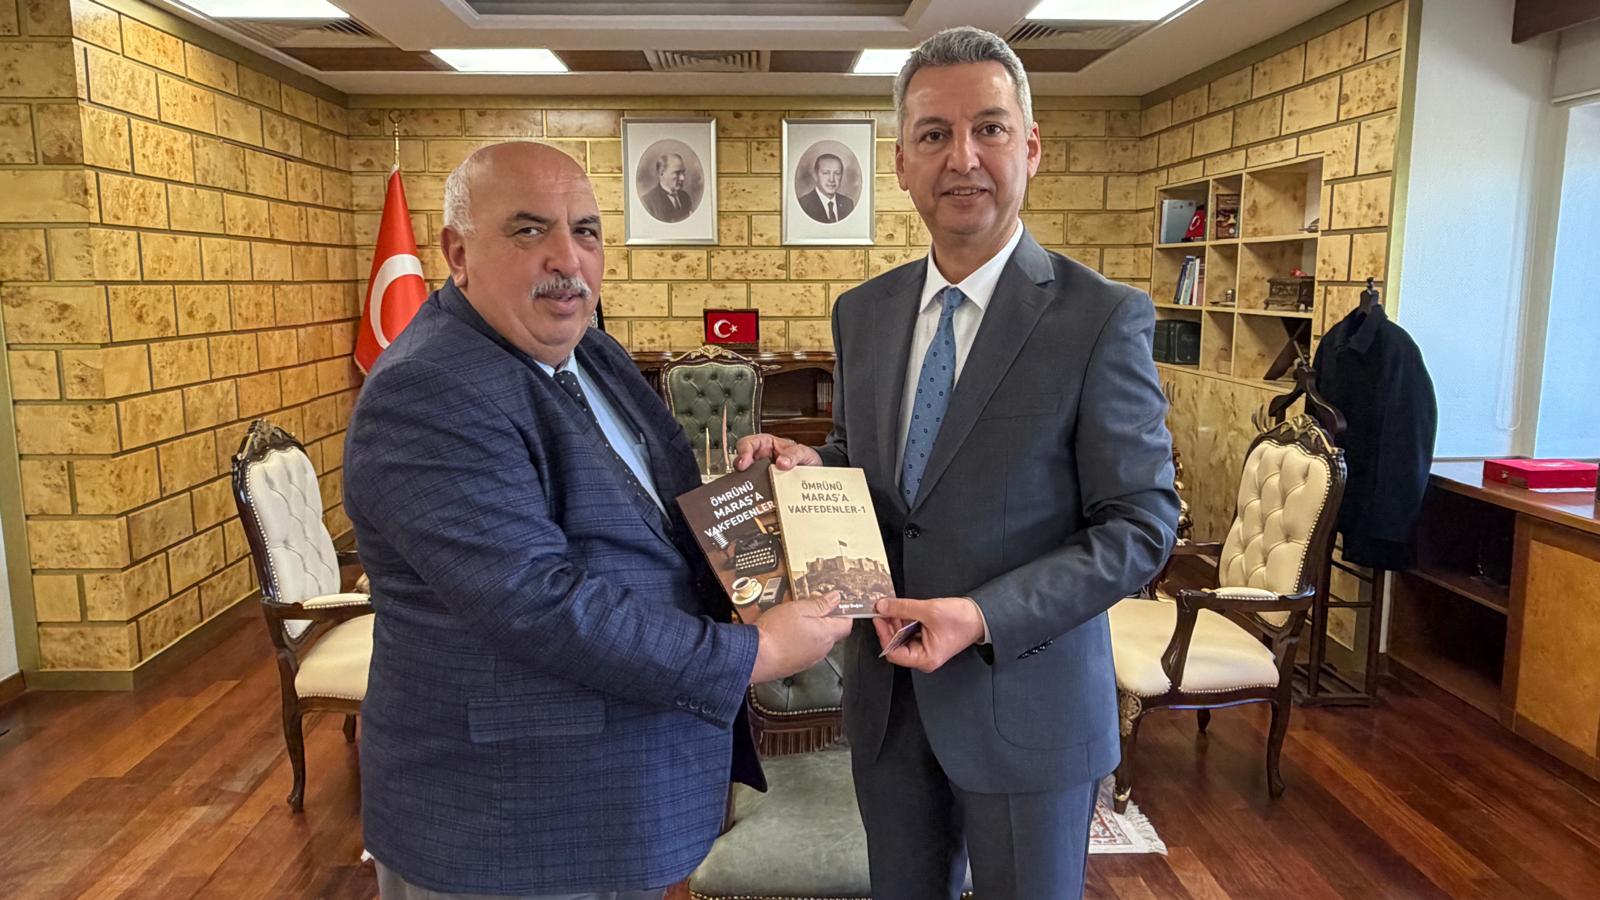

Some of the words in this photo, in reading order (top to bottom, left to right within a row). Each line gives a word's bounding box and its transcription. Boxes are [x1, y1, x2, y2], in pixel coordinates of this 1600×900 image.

[709, 480, 754, 506] ÖMRÜNÜ
[801, 480, 843, 490] ÖMRÜNÜ
[713, 491, 764, 519] MARAŞ'A
[801, 493, 849, 502] MARAŞ'A
[704, 500, 776, 537] VAKFEDENLER
[787, 505, 866, 514] VAKFEDENLER-1
